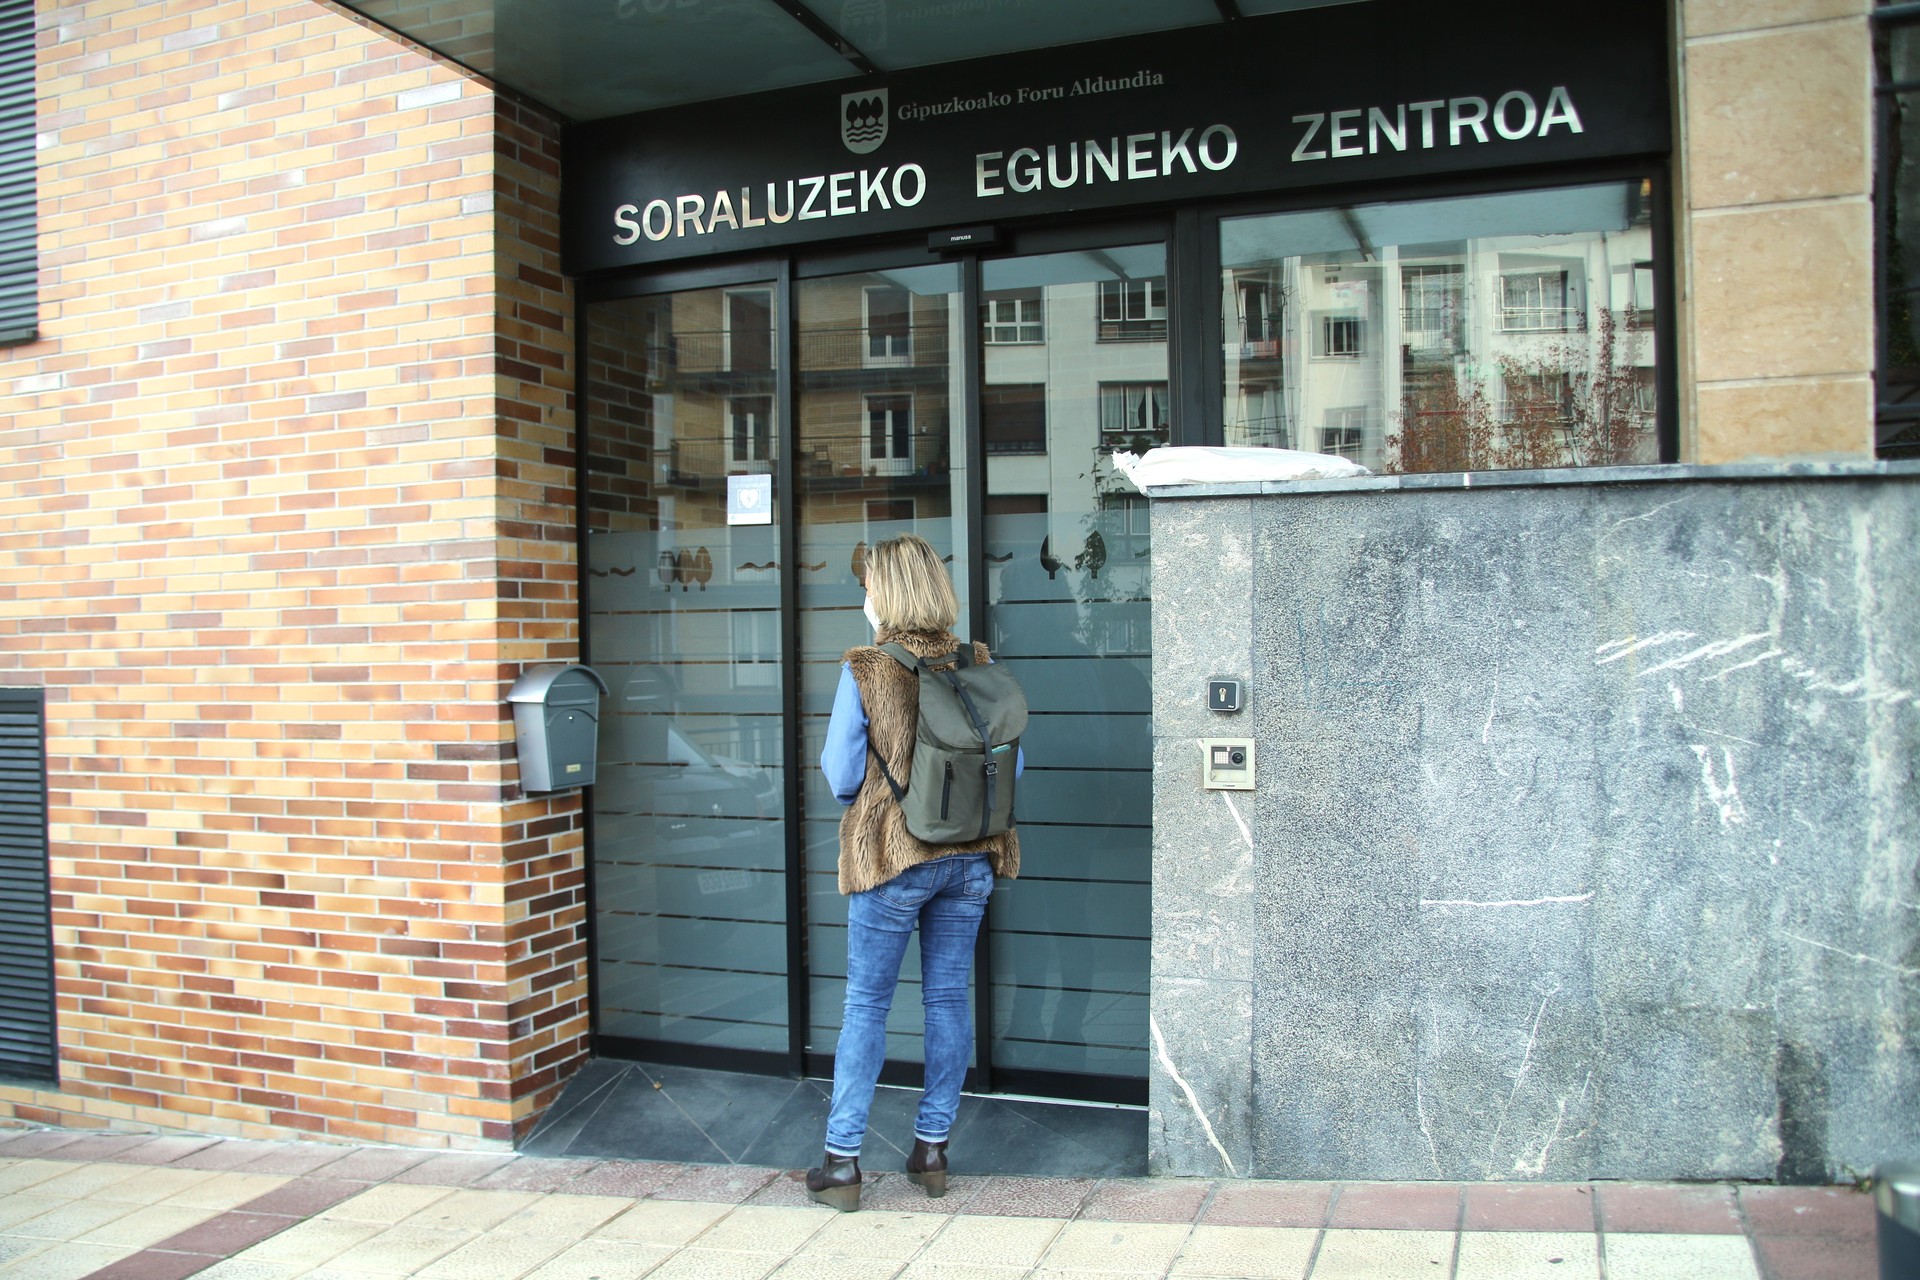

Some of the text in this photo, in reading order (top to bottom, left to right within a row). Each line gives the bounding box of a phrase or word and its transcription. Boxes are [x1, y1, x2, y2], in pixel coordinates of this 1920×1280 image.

[897, 70, 1163, 121] Gipuzkoako Foru Aldundia
[612, 86, 1584, 246] SORALUZEKO EGUNEKO ZENTROA
